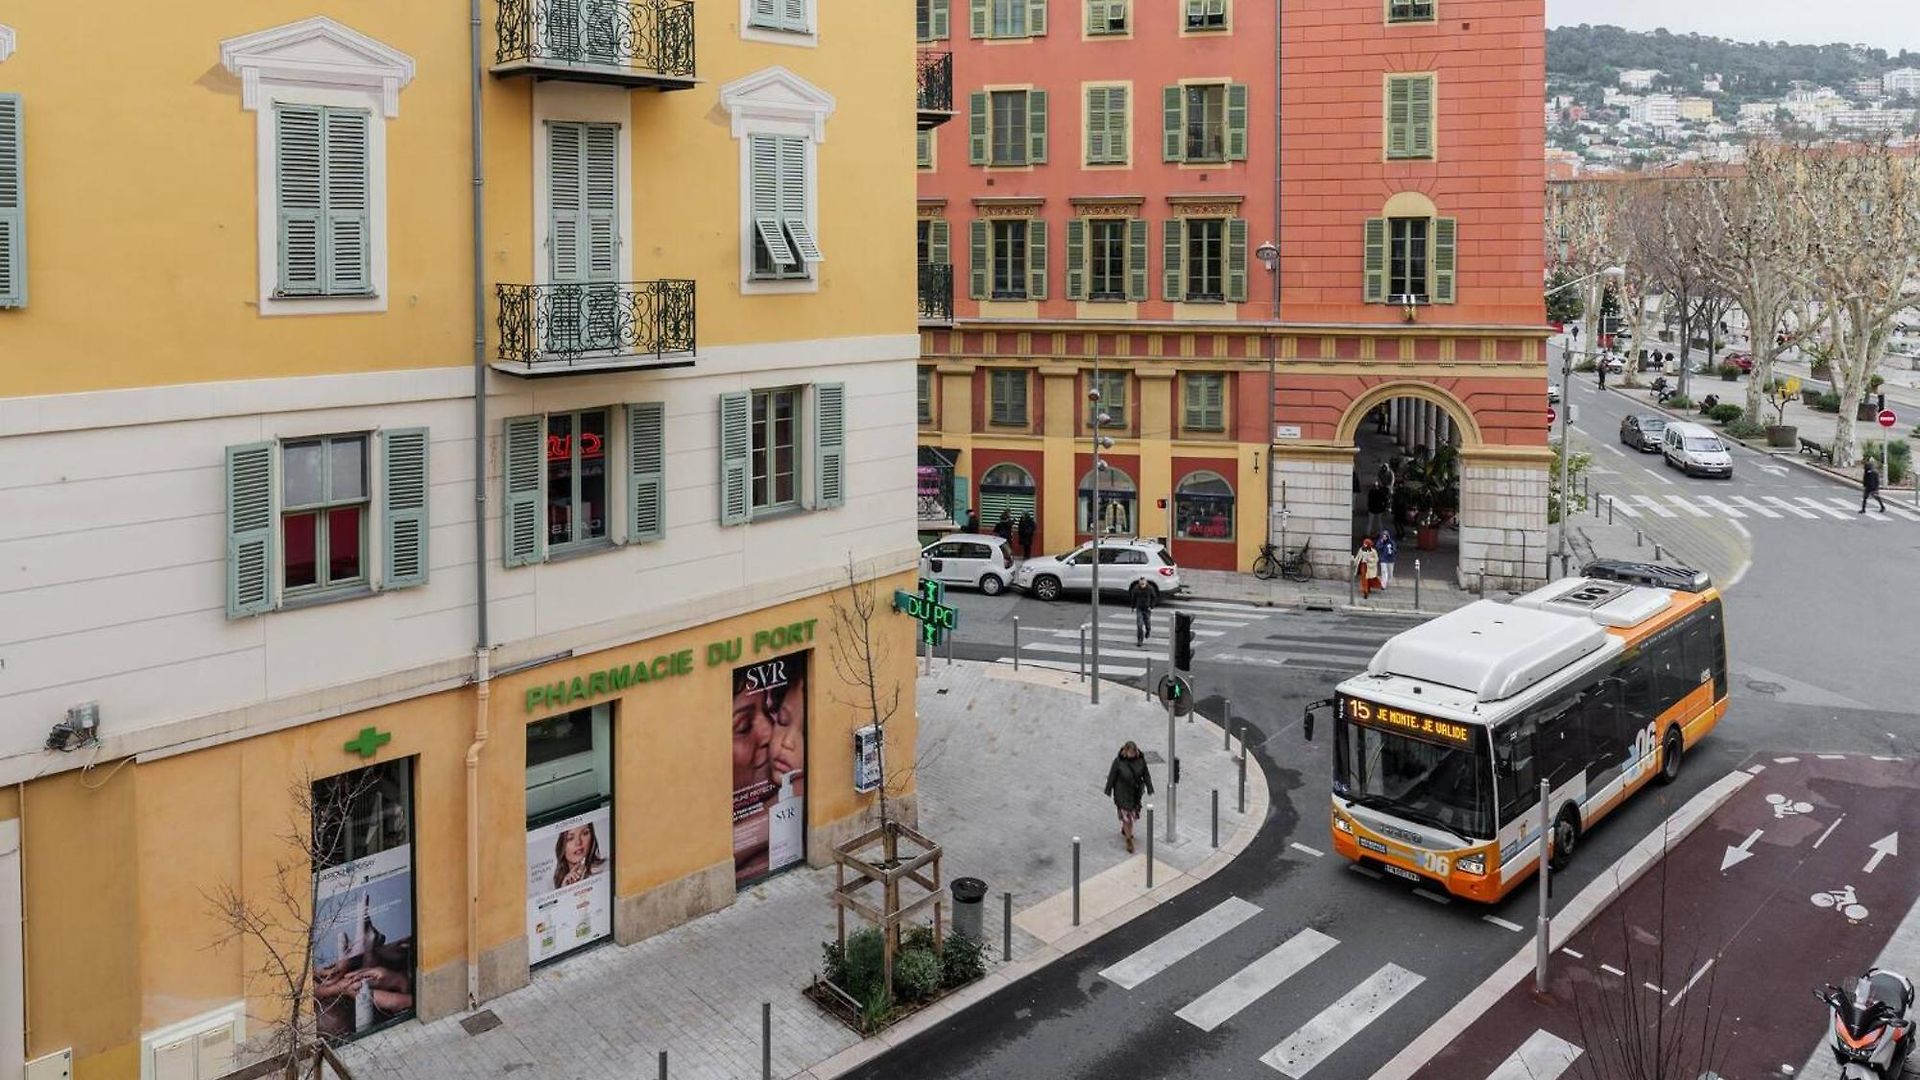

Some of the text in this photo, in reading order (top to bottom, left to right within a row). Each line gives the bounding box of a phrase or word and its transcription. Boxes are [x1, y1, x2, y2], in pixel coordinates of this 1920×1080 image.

[908, 597, 930, 619] DU
[526, 618, 819, 713] PHARMACIE DU PORT
[745, 660, 788, 690] SVR
[1350, 700, 1371, 720] 15
[1376, 708, 1388, 722] JE
[1421, 719, 1434, 733] JE
[1435, 721, 1468, 741] VALIDE
[775, 806, 796, 820] SVR
[1423, 852, 1450, 877] 06
